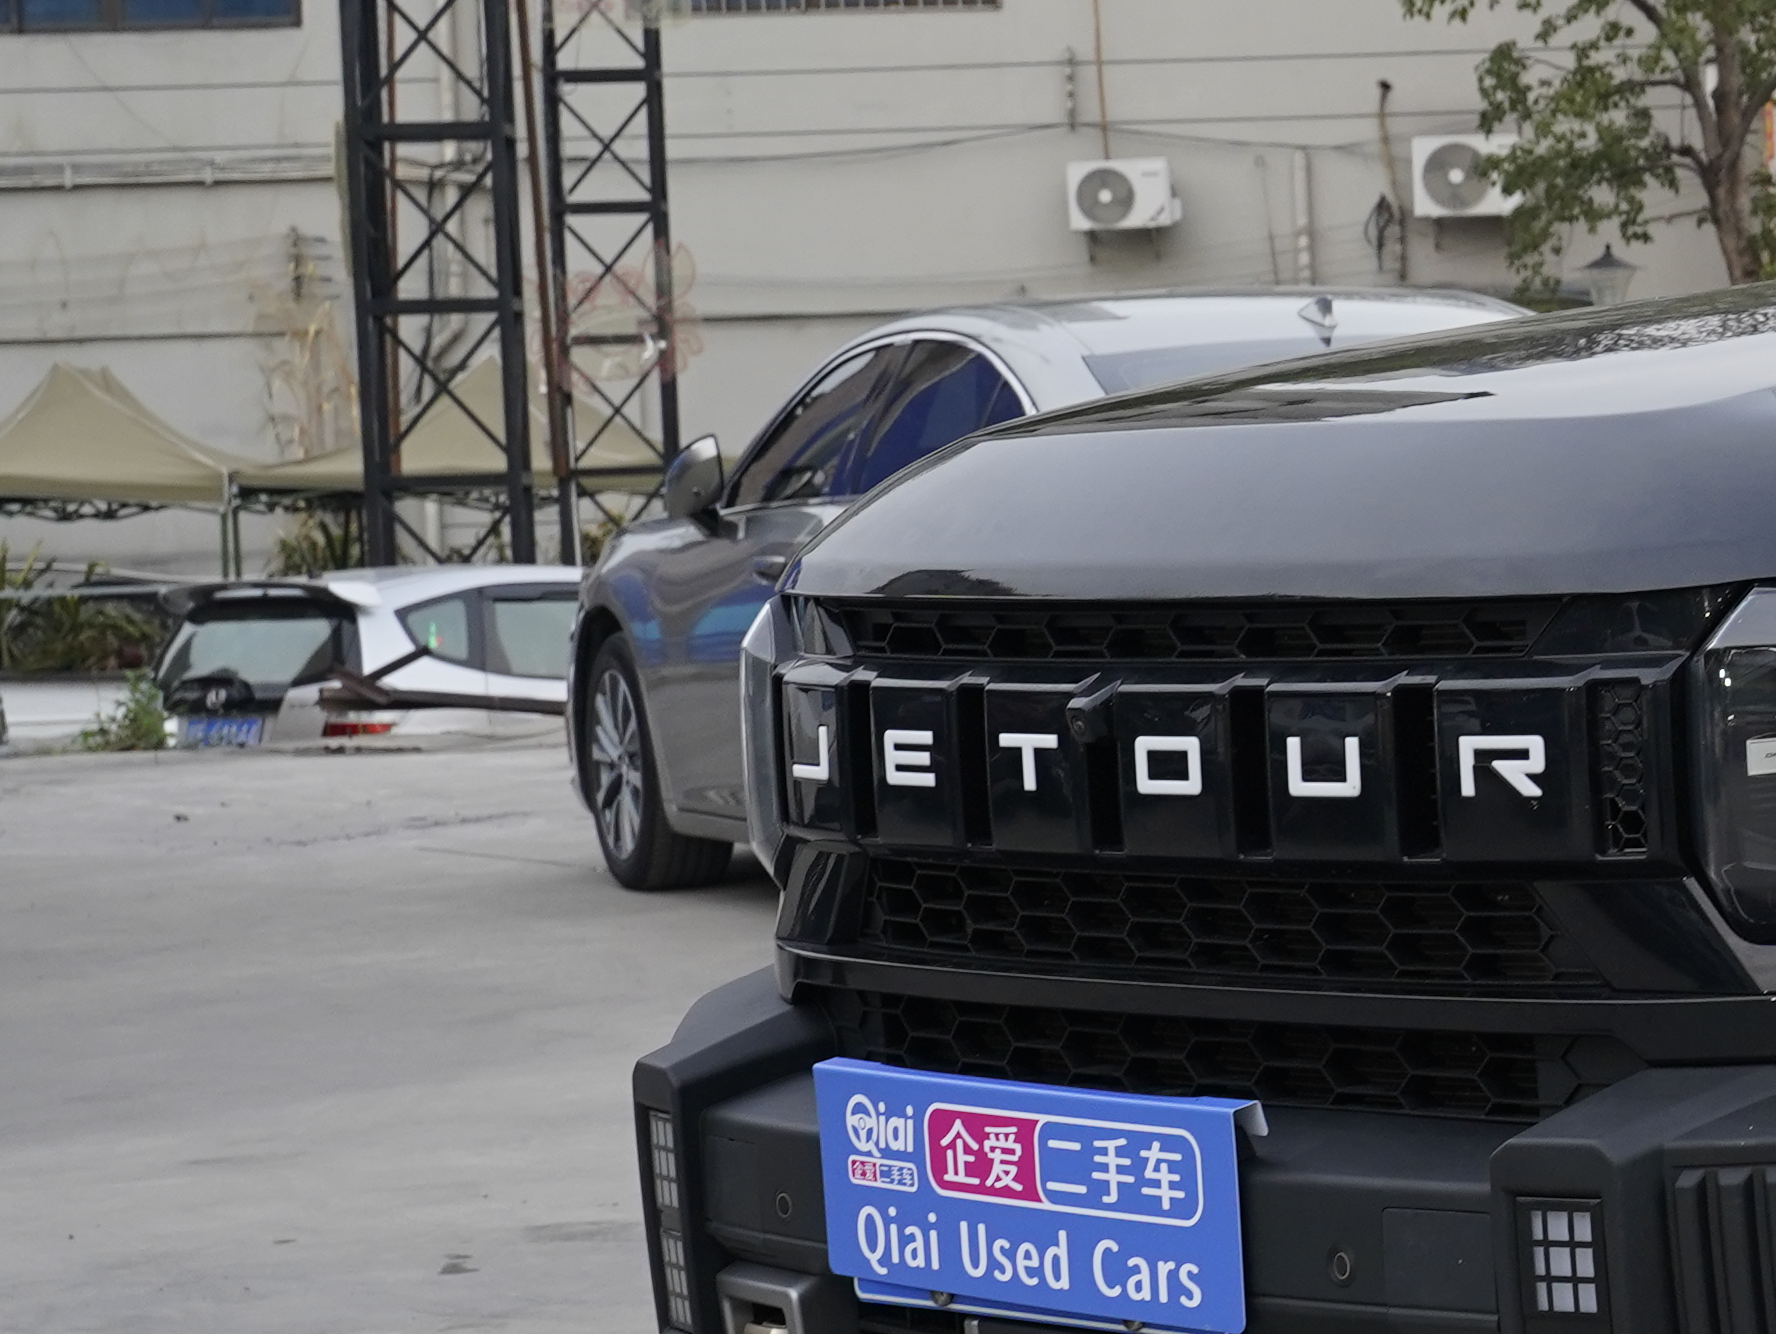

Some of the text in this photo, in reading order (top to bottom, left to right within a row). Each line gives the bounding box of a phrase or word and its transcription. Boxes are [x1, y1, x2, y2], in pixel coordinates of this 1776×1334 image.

[792, 725, 1547, 798] JETOUR
[846, 1093, 914, 1158] Qiai
[939, 1118, 1186, 1211] 企爱二手车
[857, 1205, 1202, 1309] Qiai Used Cars
